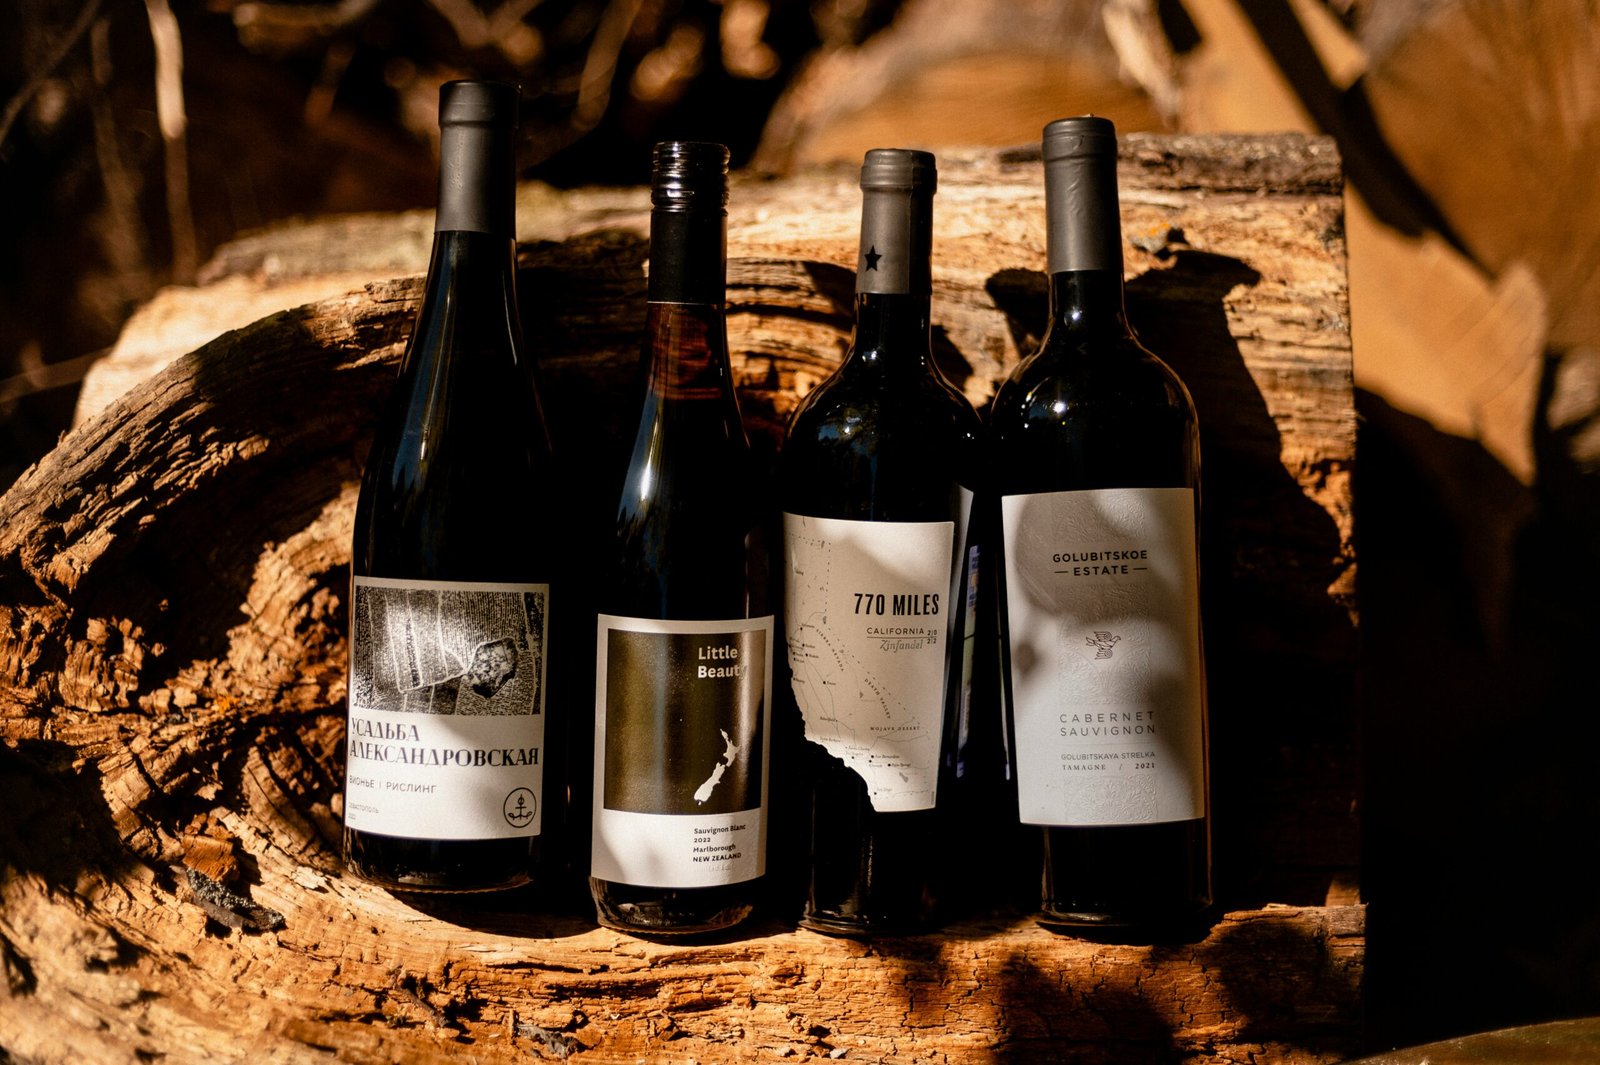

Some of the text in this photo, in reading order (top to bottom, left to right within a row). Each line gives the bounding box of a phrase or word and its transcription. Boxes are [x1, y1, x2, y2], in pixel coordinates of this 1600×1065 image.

[1052, 550, 1148, 562] GOLUBITSKOE
[1073, 565, 1128, 576] ESTATE
[854, 593, 939, 616] 770 MILES
[866, 627, 925, 635] CALIFORNIA
[879, 639, 924, 653] Zinfandel
[698, 645, 738, 660] Little
[1059, 711, 1154, 723] CABERNET
[351, 717, 420, 742] УСАДЬБА
[1060, 725, 1155, 736] SAUVIGNON
[350, 739, 539, 767] АЛЕКСАНДРОВСКАЯ
[1061, 751, 1156, 761] GOLUBITSKAYA STRELKA
[386, 781, 437, 793] РИСЛИНГ
[693, 824, 746, 835] Sauvignon Blanc
[693, 843, 736, 852] Marlborough
[712, 852, 742, 861] ZEALAND
